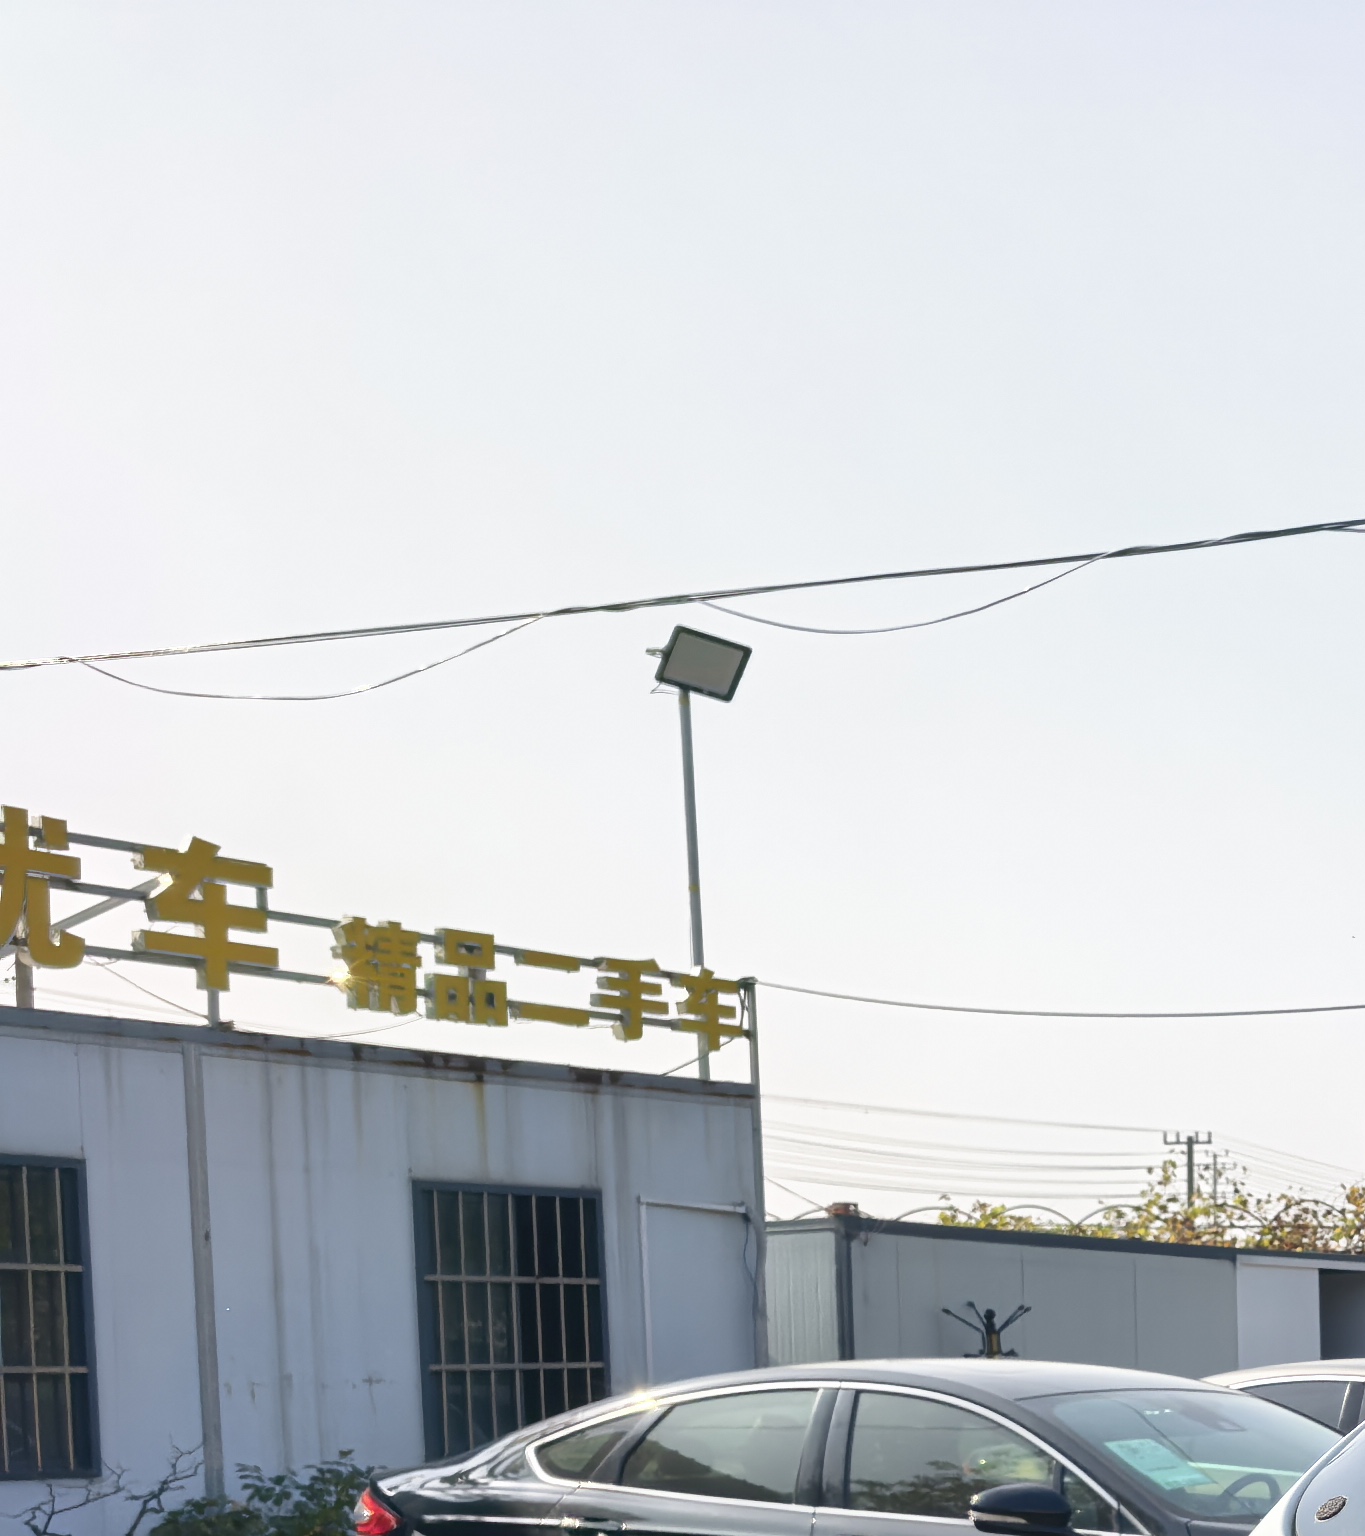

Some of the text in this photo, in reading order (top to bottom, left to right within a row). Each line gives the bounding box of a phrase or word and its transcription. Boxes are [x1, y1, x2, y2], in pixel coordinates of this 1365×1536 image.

[331, 916, 743, 1051] 精品二手车
